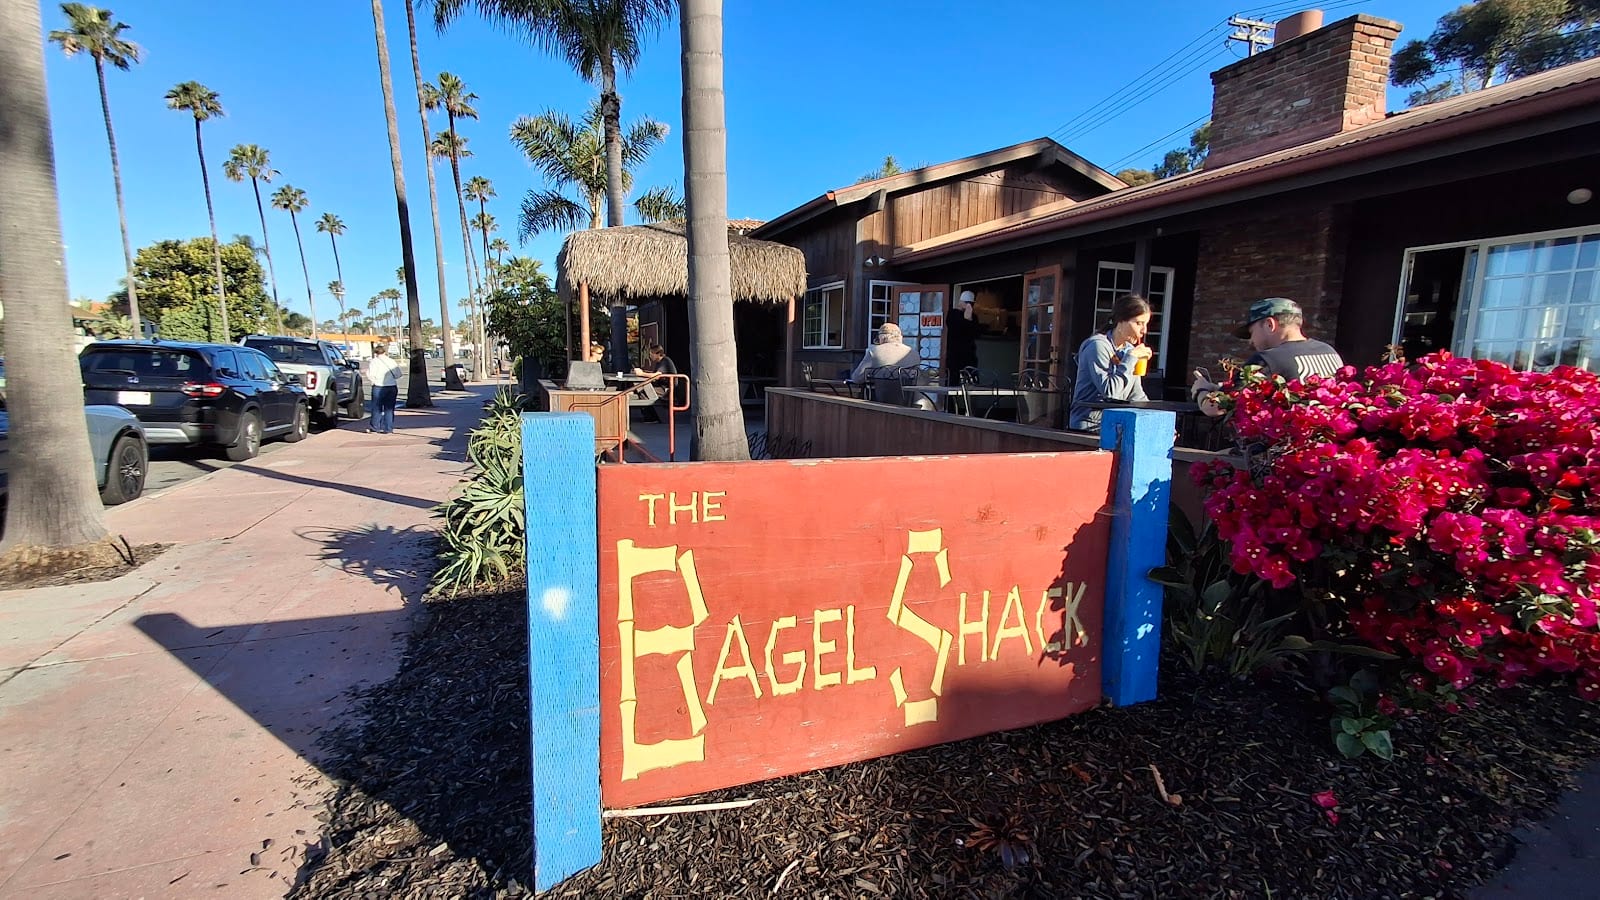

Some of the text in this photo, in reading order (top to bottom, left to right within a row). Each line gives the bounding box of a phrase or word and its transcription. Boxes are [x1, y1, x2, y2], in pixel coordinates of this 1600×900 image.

[921, 315, 942, 327] OPEN
[639, 490, 727, 525] THE
[616, 528, 1089, 781] BAGEL SHACK
